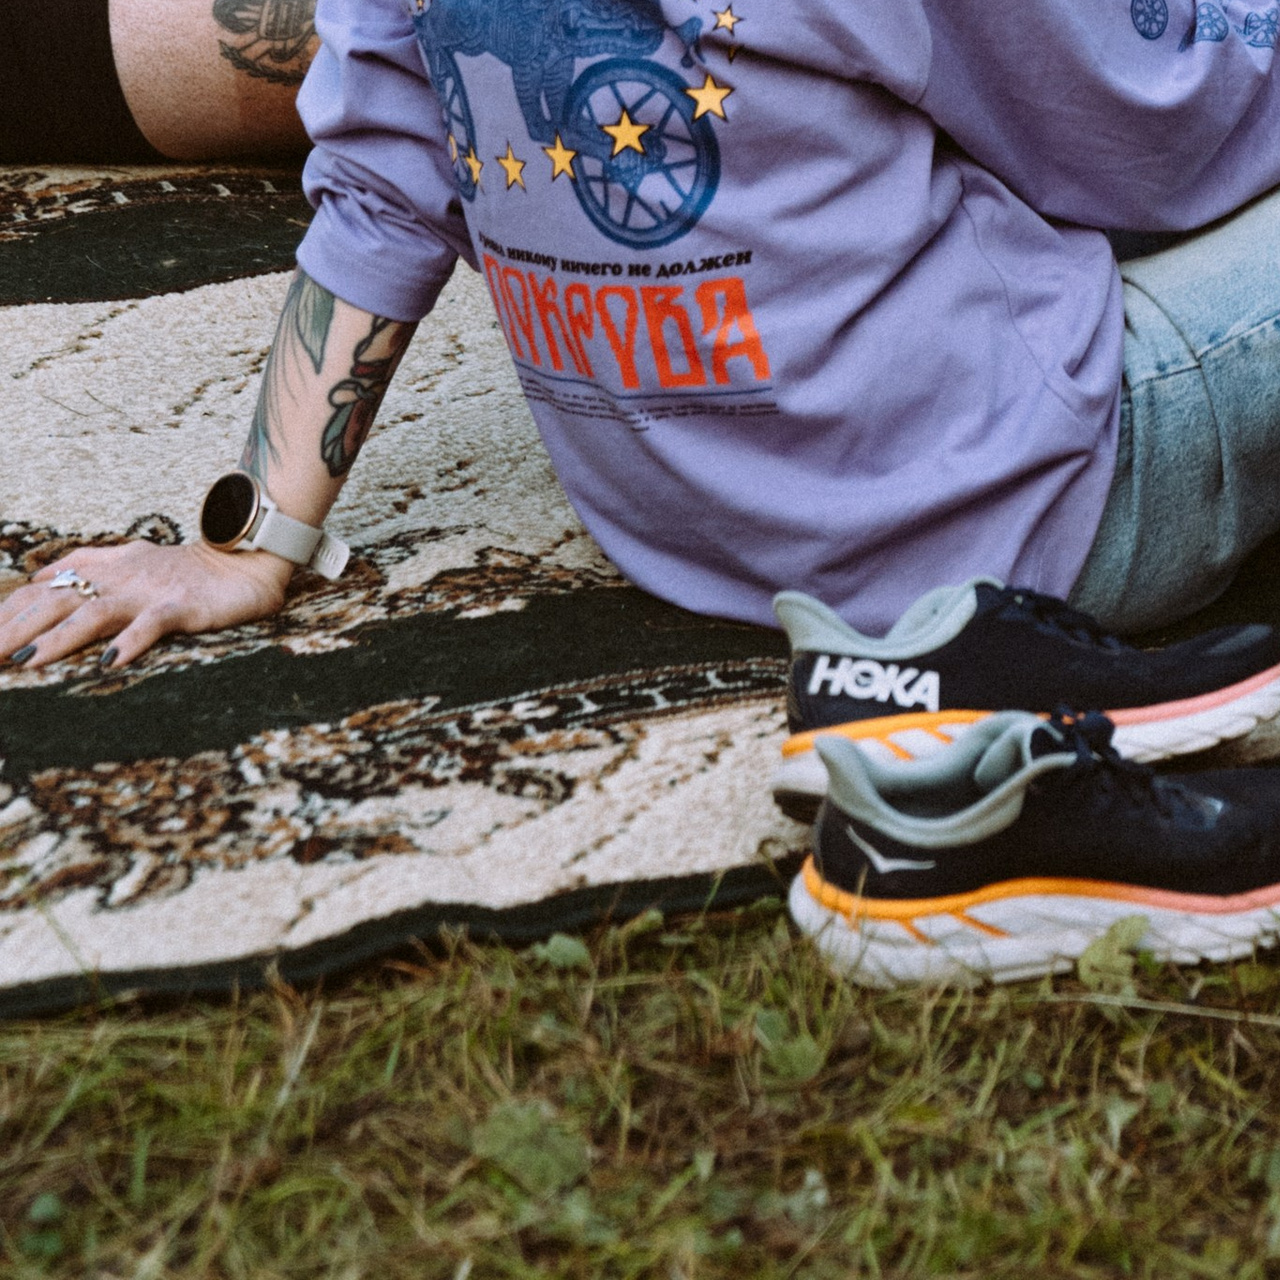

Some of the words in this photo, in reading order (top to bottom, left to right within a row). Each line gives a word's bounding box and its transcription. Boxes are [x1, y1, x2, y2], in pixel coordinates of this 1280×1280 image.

[506, 246, 558, 273] никому
[560, 257, 623, 278] ничего
[627, 260, 653, 278] не
[655, 249, 754, 281] должен
[807, 653, 941, 714] HOKA
